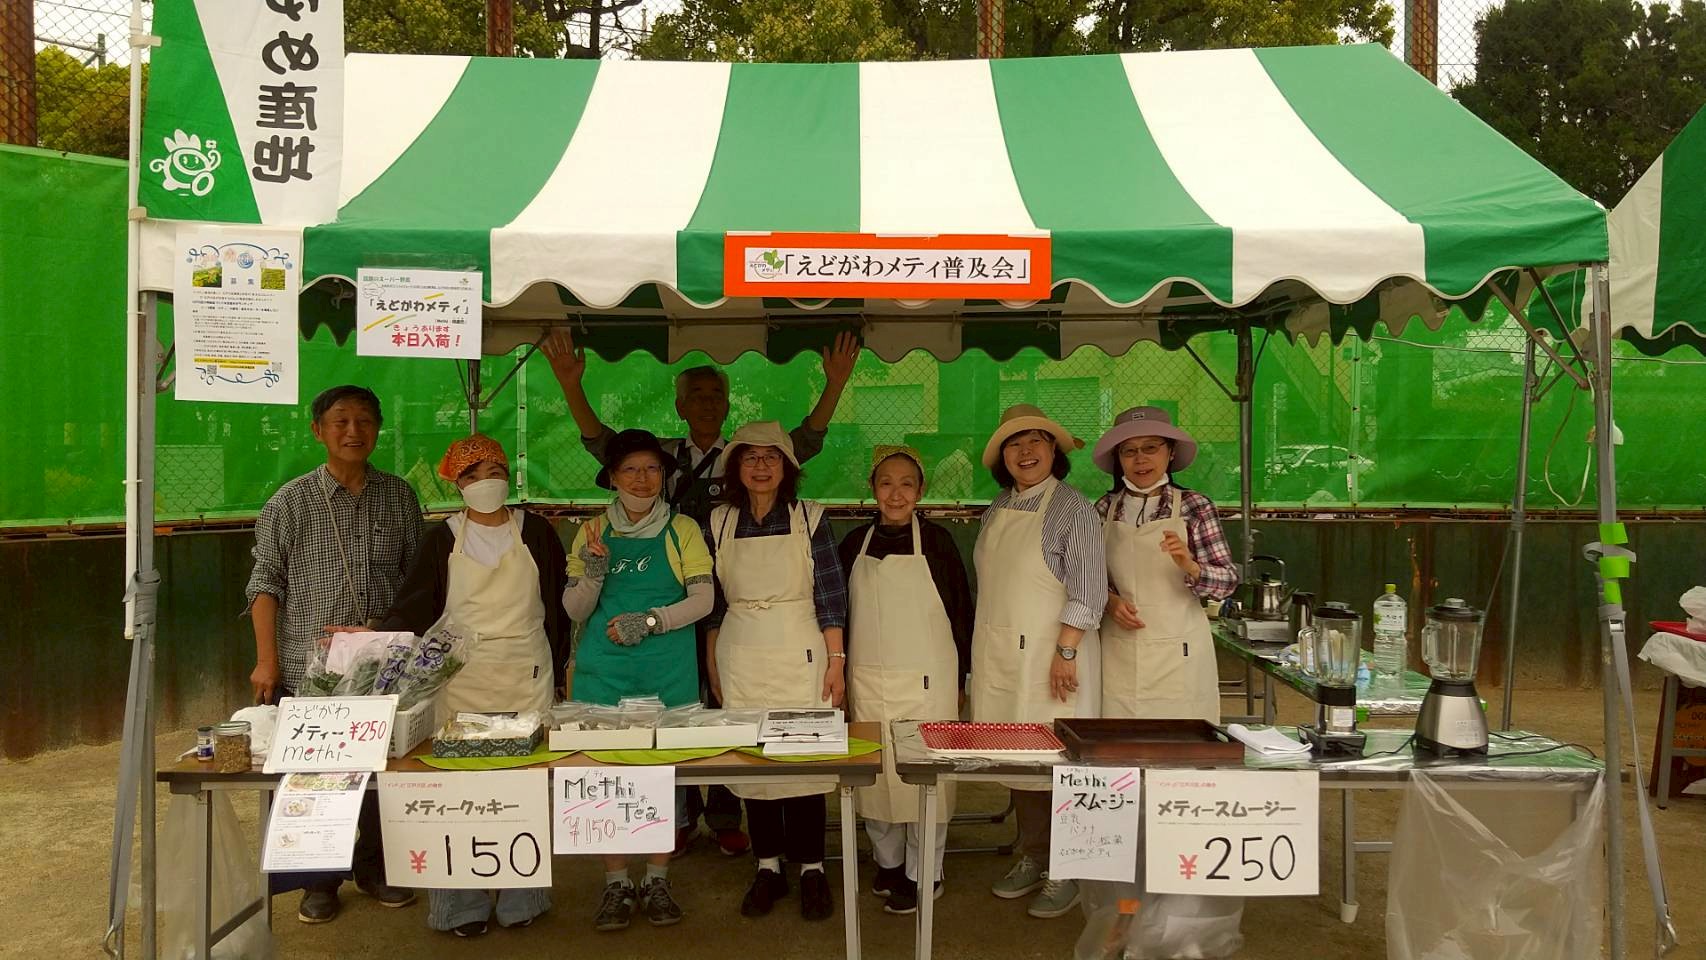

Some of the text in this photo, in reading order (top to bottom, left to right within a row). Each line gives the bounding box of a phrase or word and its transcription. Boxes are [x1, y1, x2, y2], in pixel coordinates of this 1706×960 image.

[785, 253, 1027, 280] 「えどがわメティ普及会」
[391, 332, 462, 348] 本日入荷！
[287, 702, 351, 721] えどがわ
[350, 719, 387, 742] ¥250
[564, 775, 636, 801] Methi
[1060, 773, 1107, 787] Methi
[404, 798, 520, 816] メティークッキー
[1073, 792, 1134, 811] スムージー
[1157, 800, 1297, 818] メティースムージー
[616, 801, 661, 823] Tea
[409, 831, 541, 878] ¥150
[1178, 834, 1296, 881] ¥250
